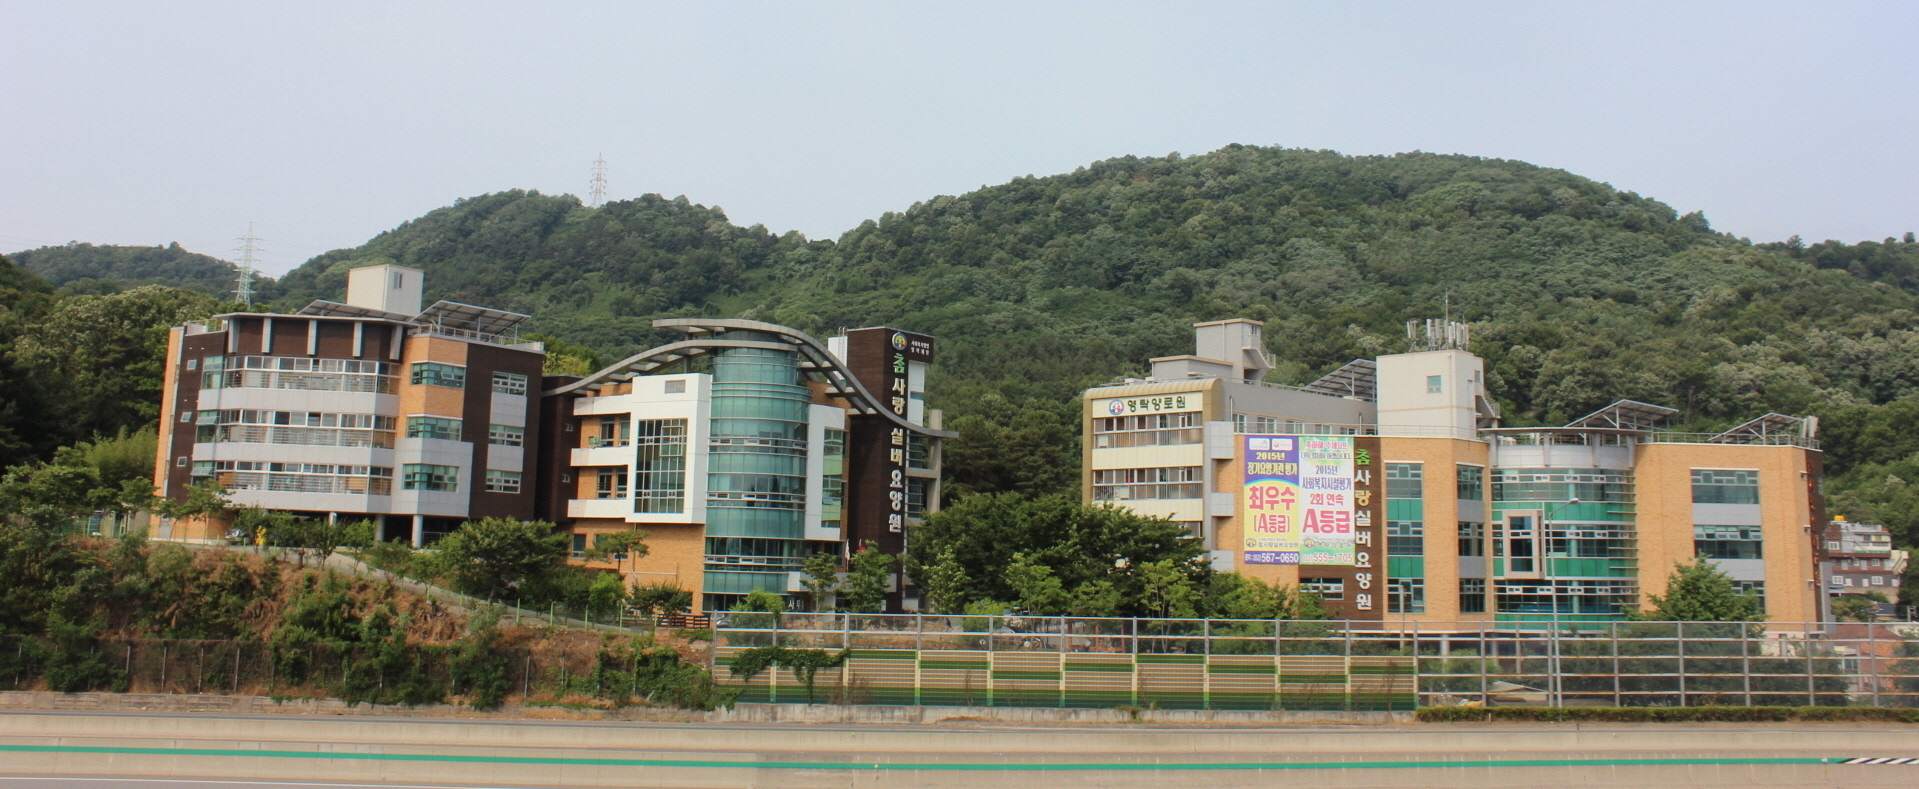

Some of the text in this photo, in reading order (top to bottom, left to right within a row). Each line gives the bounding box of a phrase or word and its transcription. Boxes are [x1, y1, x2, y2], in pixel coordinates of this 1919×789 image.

[1127, 395, 1186, 413] 영락양로원
[1256, 452, 1285, 461] 2015년
[1247, 462, 1298, 476] 장기요양기관 평가
[1315, 465, 1338, 475] 2015년
[1302, 477, 1352, 491] 사회복지시설평가
[1249, 486, 1296, 511] 최우수
[1310, 493, 1344, 506] 2회 연속
[1254, 512, 1290, 534] (A등급)
[1302, 508, 1351, 534] A등급
